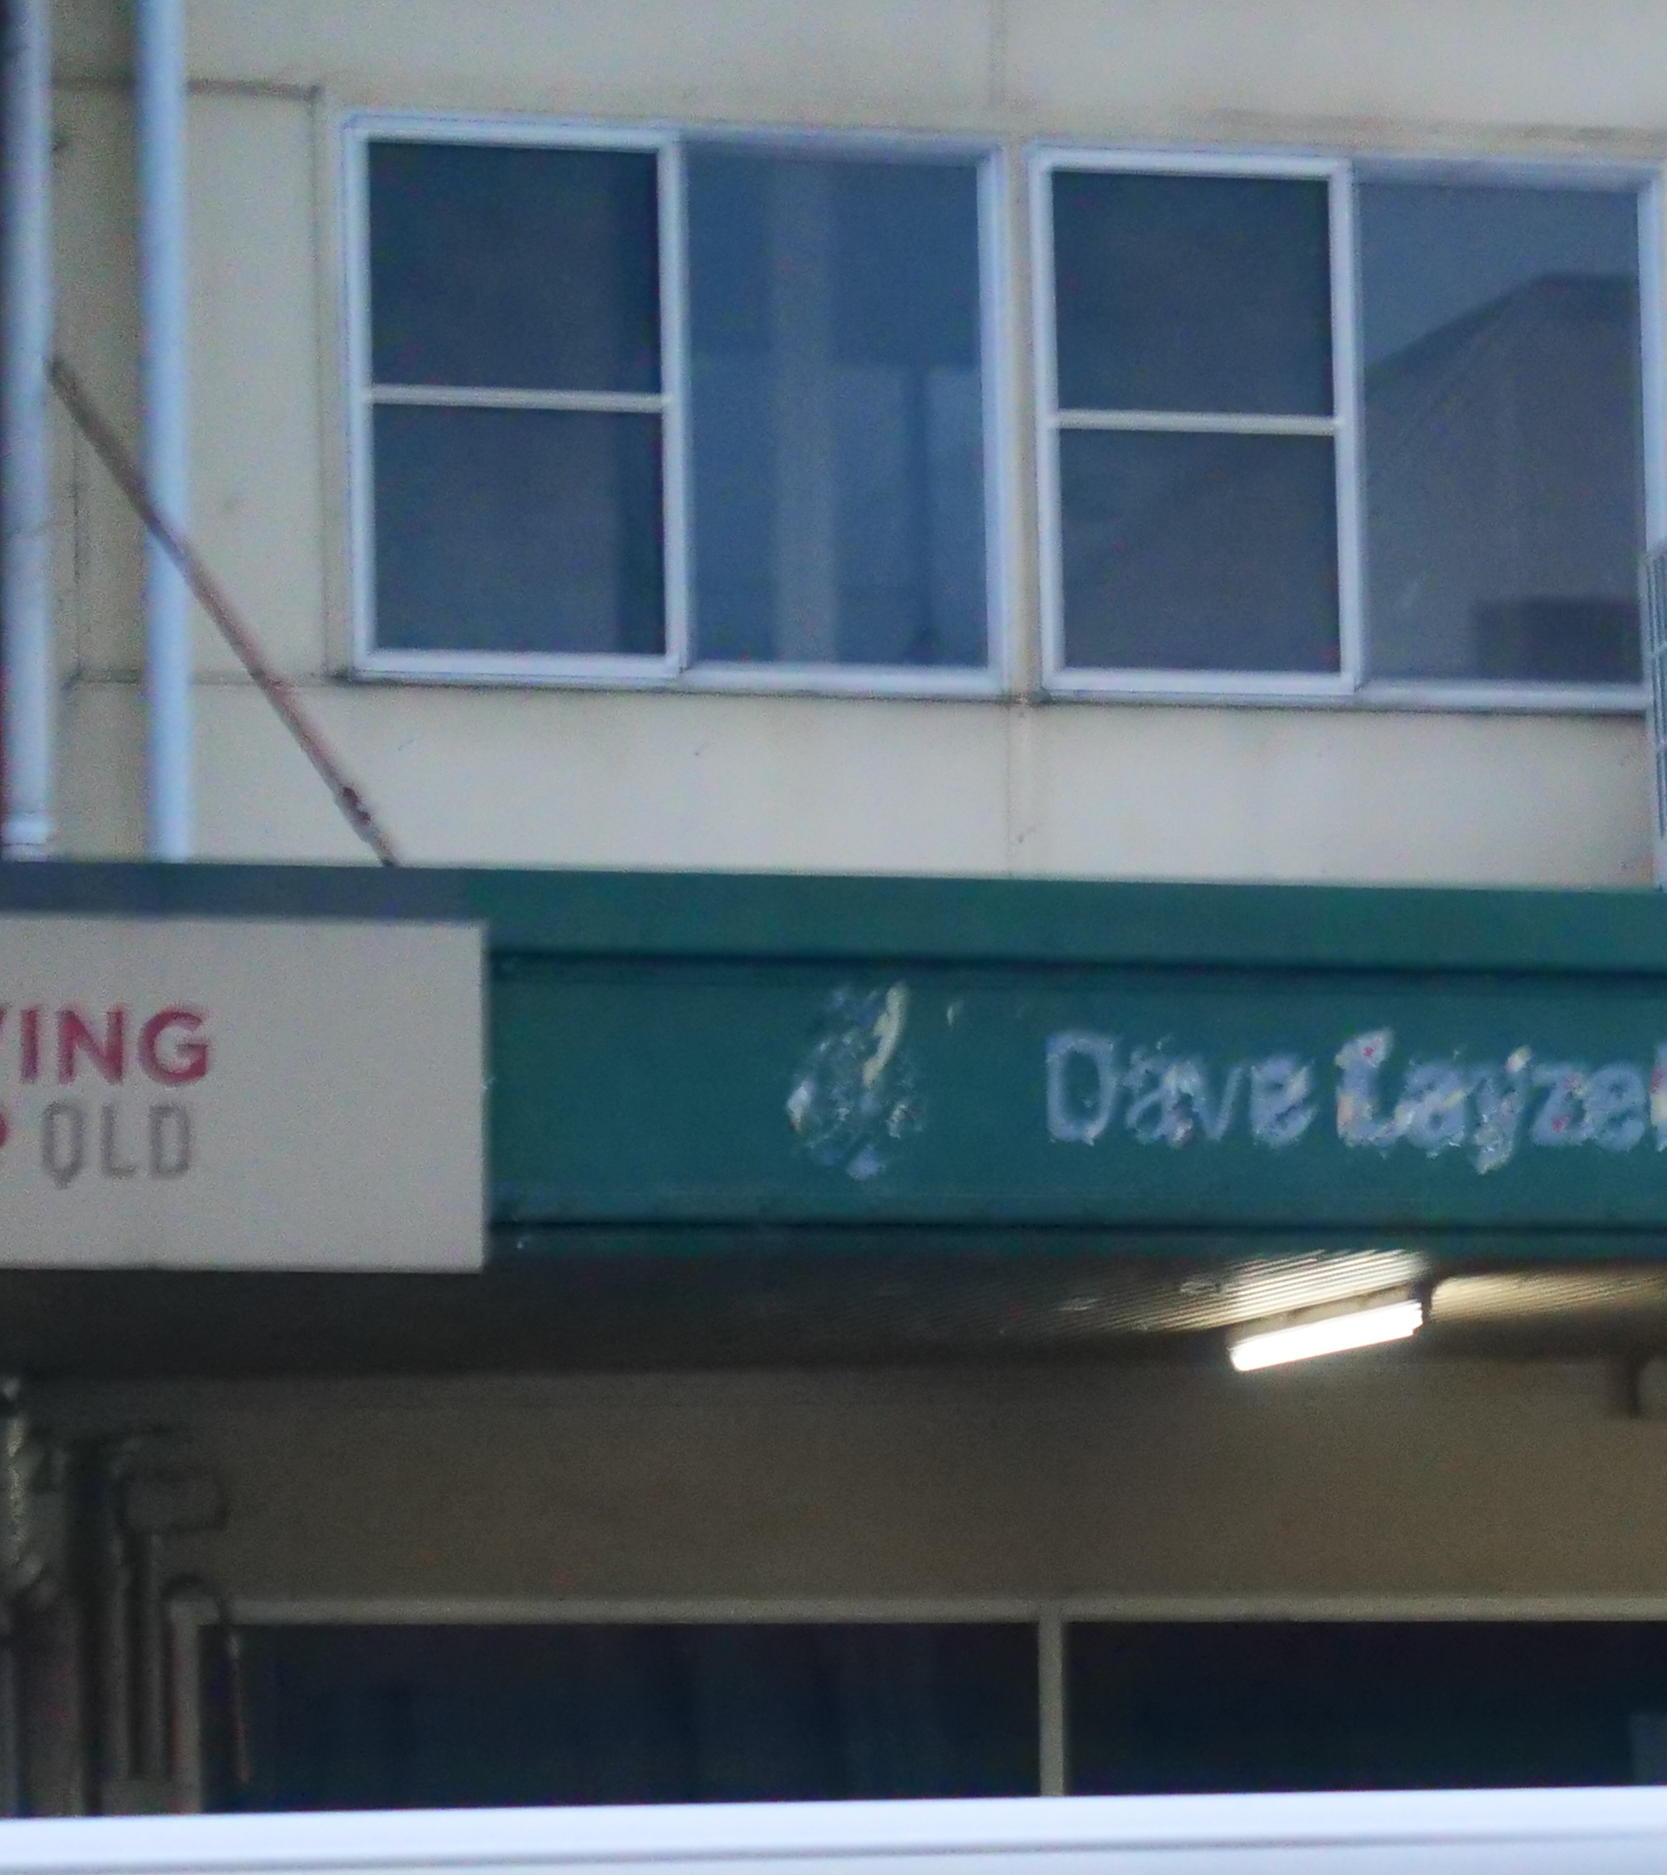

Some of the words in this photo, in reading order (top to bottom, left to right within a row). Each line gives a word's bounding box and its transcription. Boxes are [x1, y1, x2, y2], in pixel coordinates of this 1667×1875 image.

[0, 1004, 210, 1086] ING
[1044, 1028, 1313, 1147] Dave
[40, 1101, 194, 1190] QLD
